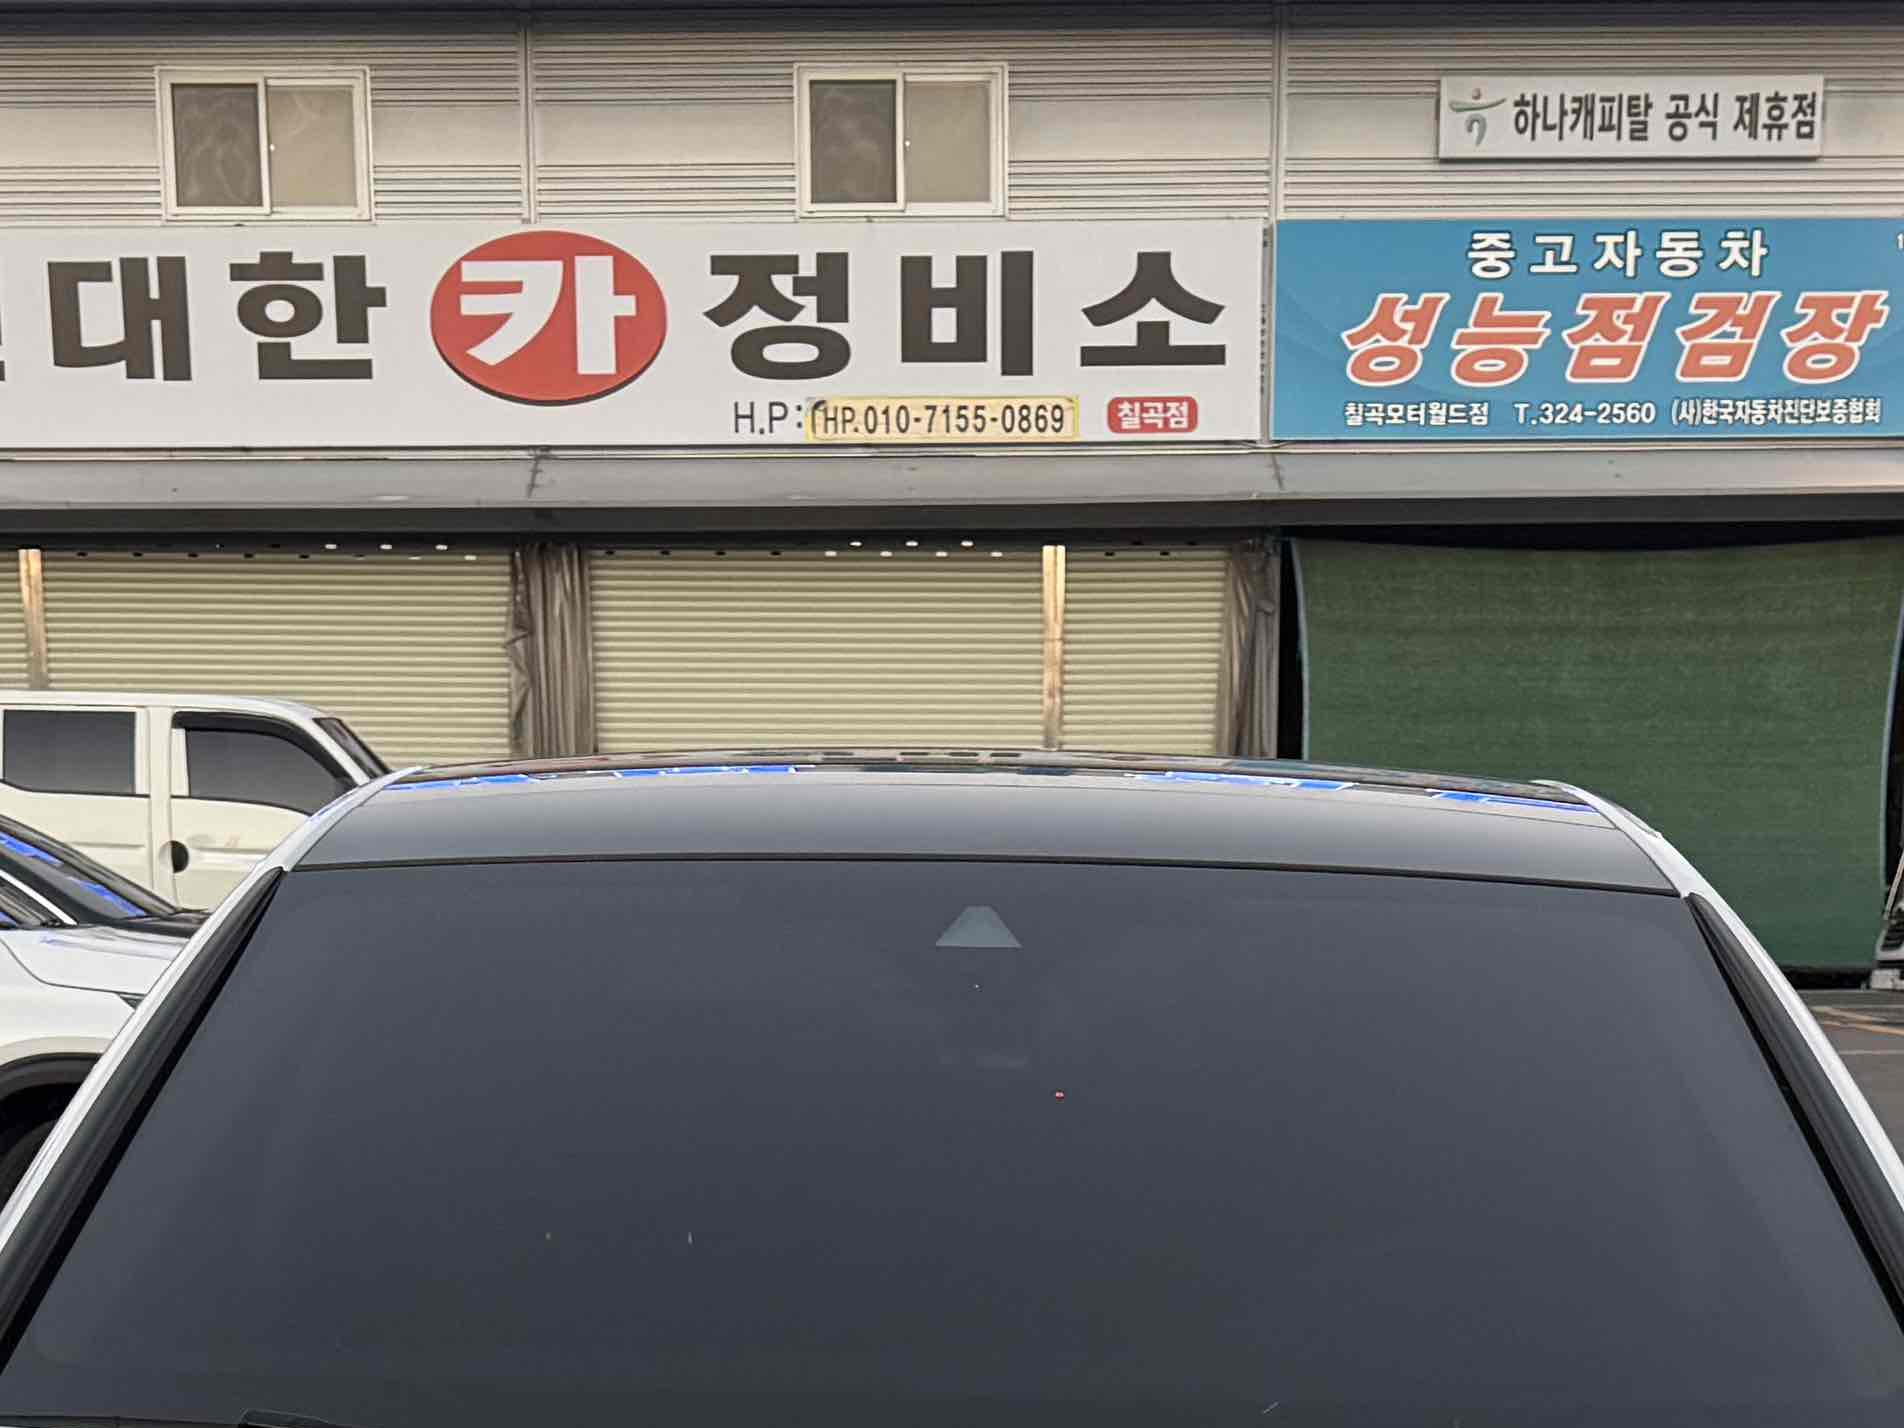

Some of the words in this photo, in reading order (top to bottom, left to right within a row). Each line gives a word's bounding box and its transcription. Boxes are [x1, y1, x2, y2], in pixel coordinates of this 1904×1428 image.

[1512, 92, 1653, 142] 하나캐피탈
[1665, 92, 1721, 142] 공식
[1733, 91, 1817, 140] 제휴점
[1467, 231, 1769, 279] 중고자동차
[459, 255, 637, 376] 카
[702, 251, 1227, 380] 정비소
[1340, 290, 1891, 387] 성능점검장
[1117, 400, 1190, 429] 칠곡점
[1344, 402, 1489, 427] 칠곡모터월드점
[1514, 401, 1656, 426] T.324-2560
